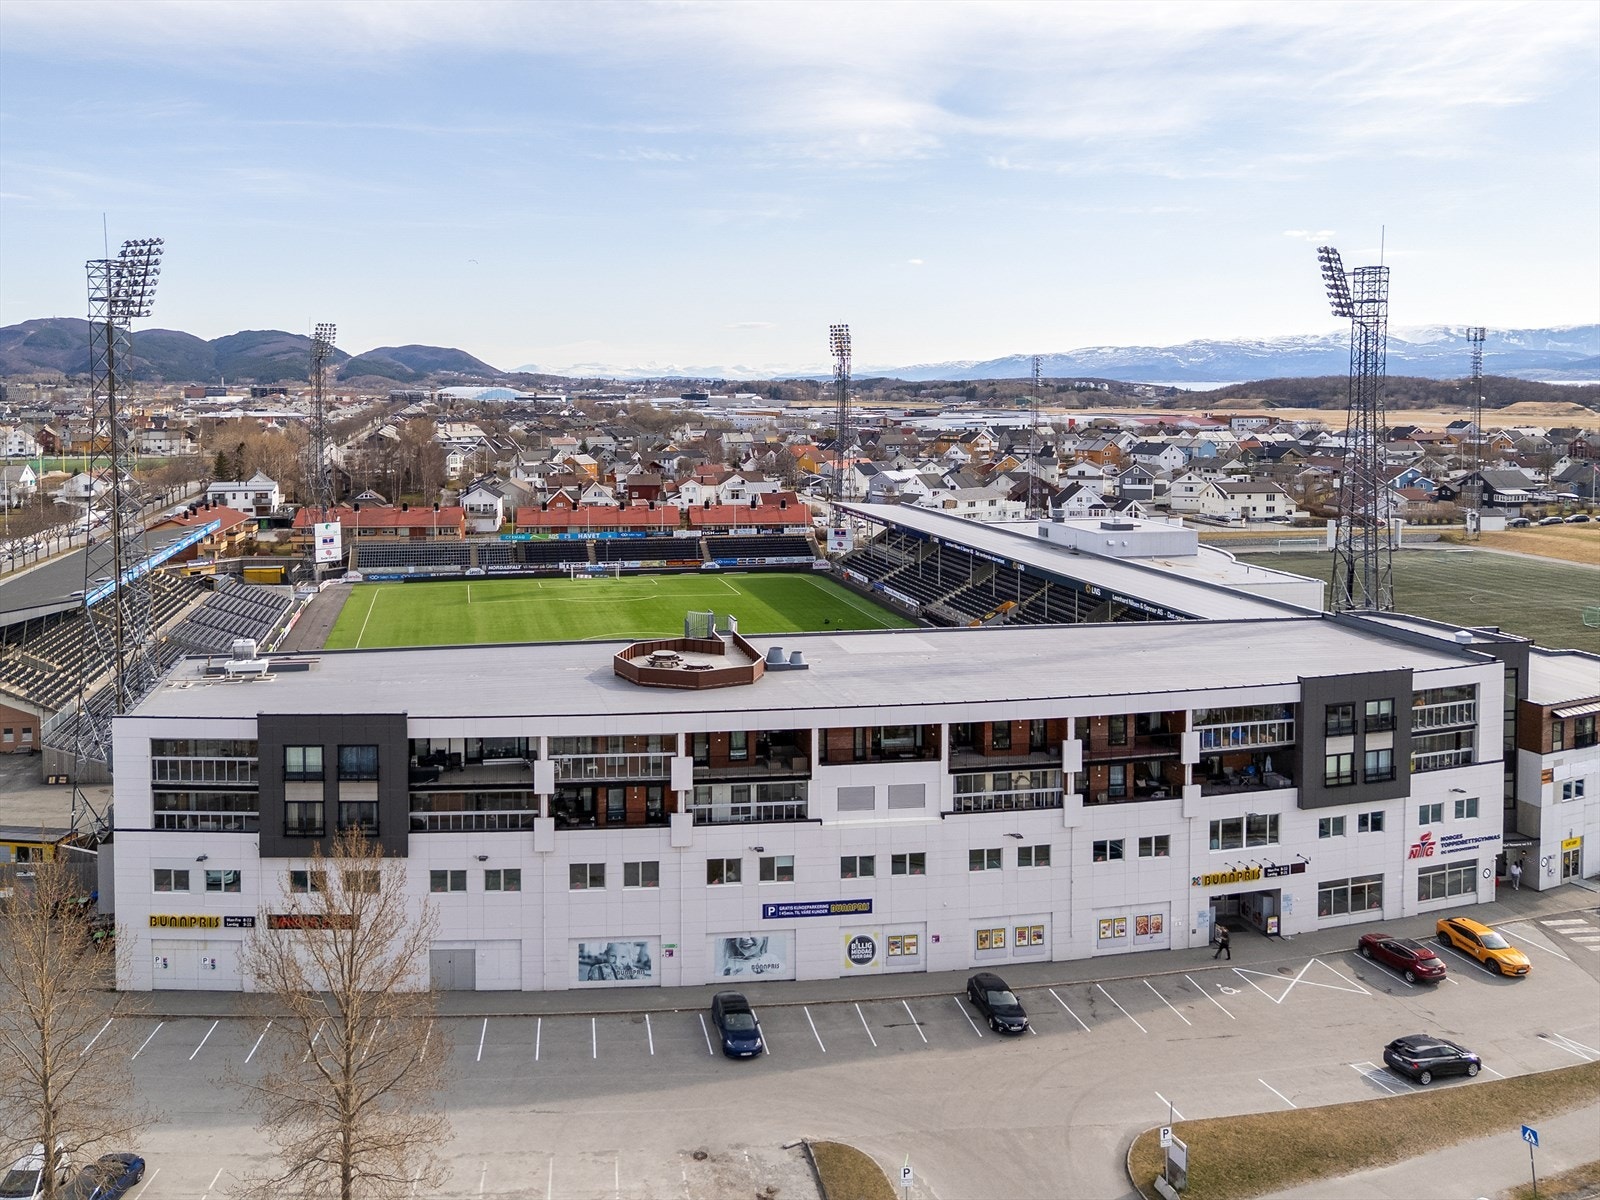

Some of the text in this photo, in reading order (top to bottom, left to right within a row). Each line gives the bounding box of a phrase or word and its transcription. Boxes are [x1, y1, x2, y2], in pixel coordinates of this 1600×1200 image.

[1091, 587, 1101, 596] LNS
[1440, 833, 1463, 842] NORGES
[1440, 834, 1500, 848] TOPPIDRETTSGYMNAS
[1408, 841, 1436, 859] NTG
[1204, 868, 1261, 886] BUNNPRIS
[768, 907, 775, 916] P
[830, 902, 870, 912] BUNNPRIS
[150, 916, 219, 928] BUNNPRIS
[1162, 1128, 1169, 1139] P
[903, 1168, 911, 1178] P
